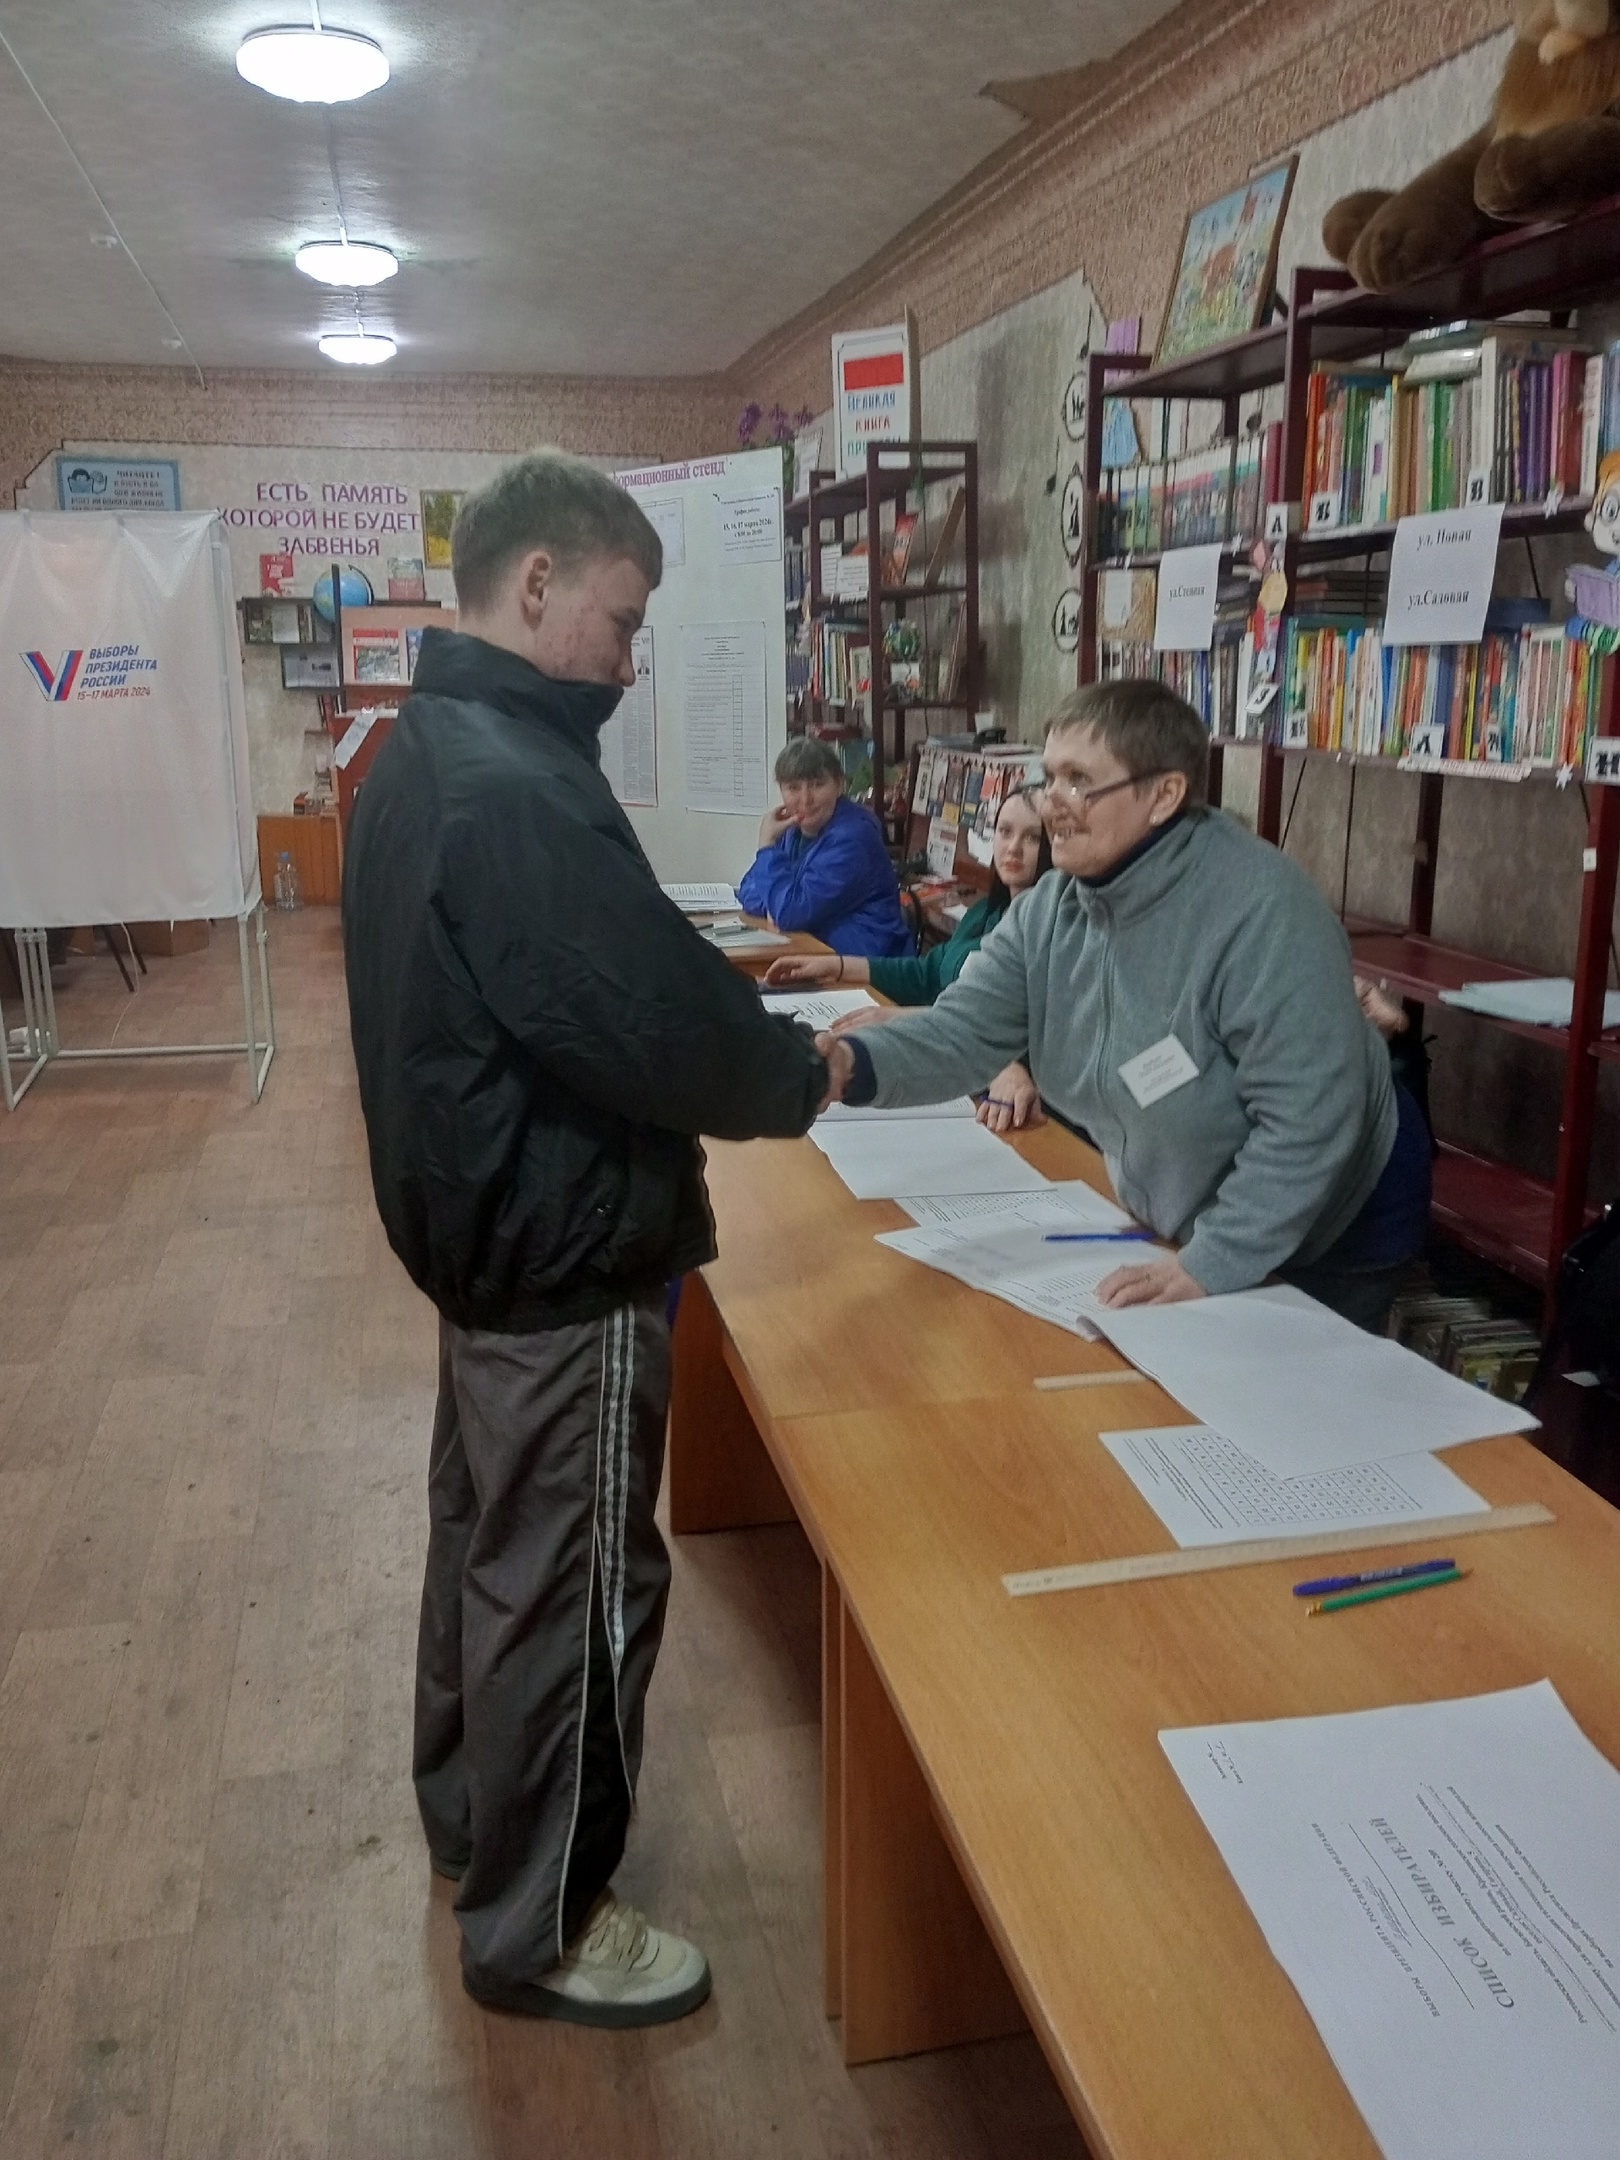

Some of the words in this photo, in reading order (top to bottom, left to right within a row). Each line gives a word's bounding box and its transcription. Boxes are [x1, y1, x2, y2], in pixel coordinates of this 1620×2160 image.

[692, 459, 726, 477] стенд
[257, 483, 308, 502] ЕСТЬ
[322, 484, 408, 504] ПАМЯТЬ
[322, 510, 349, 530] НЕ
[355, 512, 420, 533] БУДЕТ
[279, 536, 380, 556] ЗАБВЕНЬЯ
[1417, 534, 1433, 551] ул.
[1436, 528, 1472, 545] Новая
[89, 645, 140, 660] ВЫБОРЫ
[85, 659, 157, 674] ПРЕЗИДЕНТА
[80, 674, 127, 688] РОССИИ
[101, 688, 129, 699] МАРТА
[130, 686, 150, 696] 2024
[1365, 1816, 1457, 1926] ИЗБИРАТЕЛЕЙ
[1337, 1866, 1378, 1923] РОССИЙСКОЙ
[1451, 1936, 1514, 2008] СПИСОК
[1410, 1977, 1441, 2017] ВЫБОРЫ
